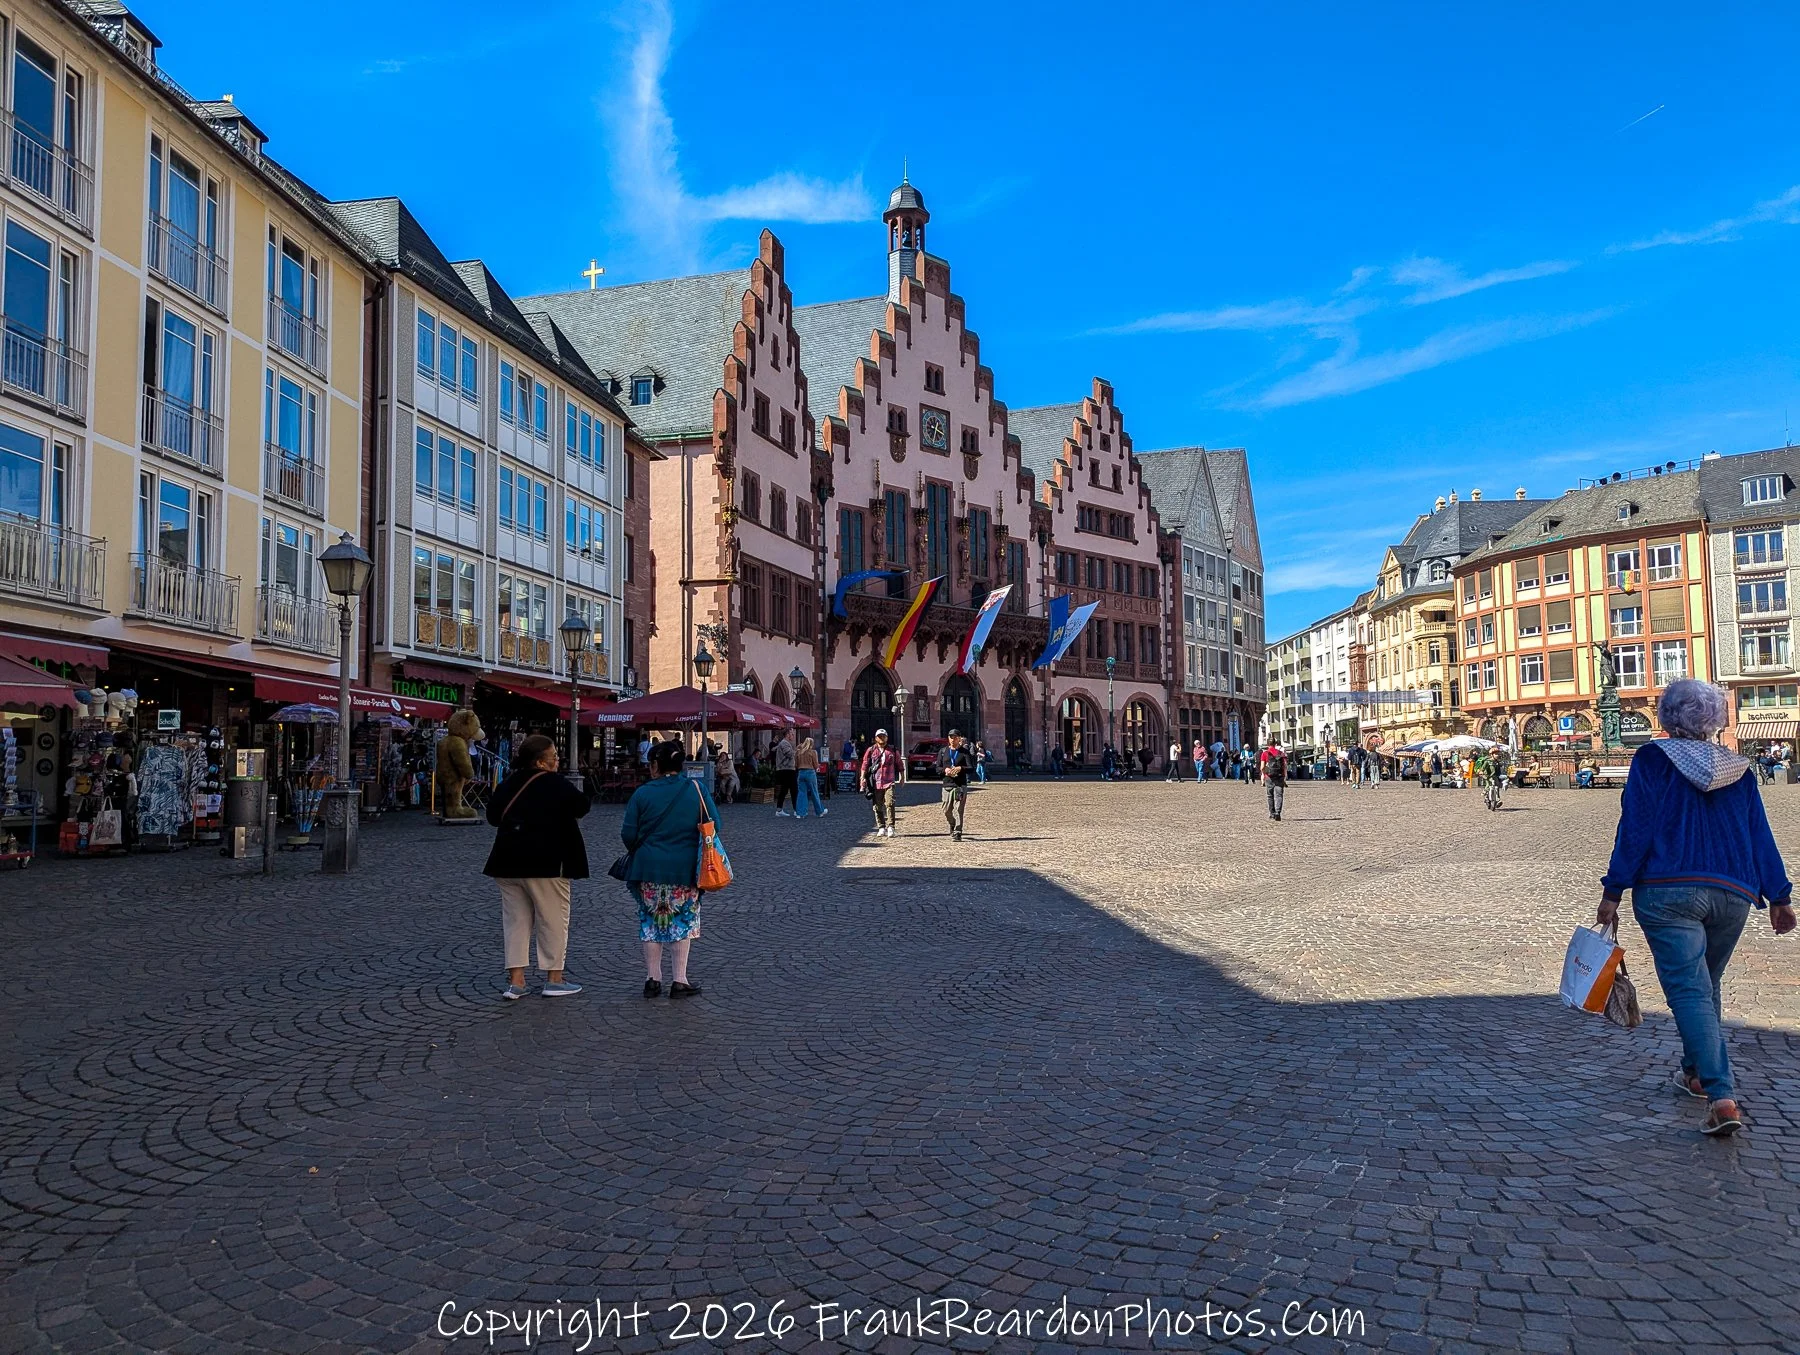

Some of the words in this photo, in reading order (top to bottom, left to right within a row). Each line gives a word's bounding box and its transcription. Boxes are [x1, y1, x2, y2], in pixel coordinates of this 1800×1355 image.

[393, 681, 458, 703] TRACHTEN
[597, 713, 636, 723] Henninger
[1560, 718, 1572, 729] U
